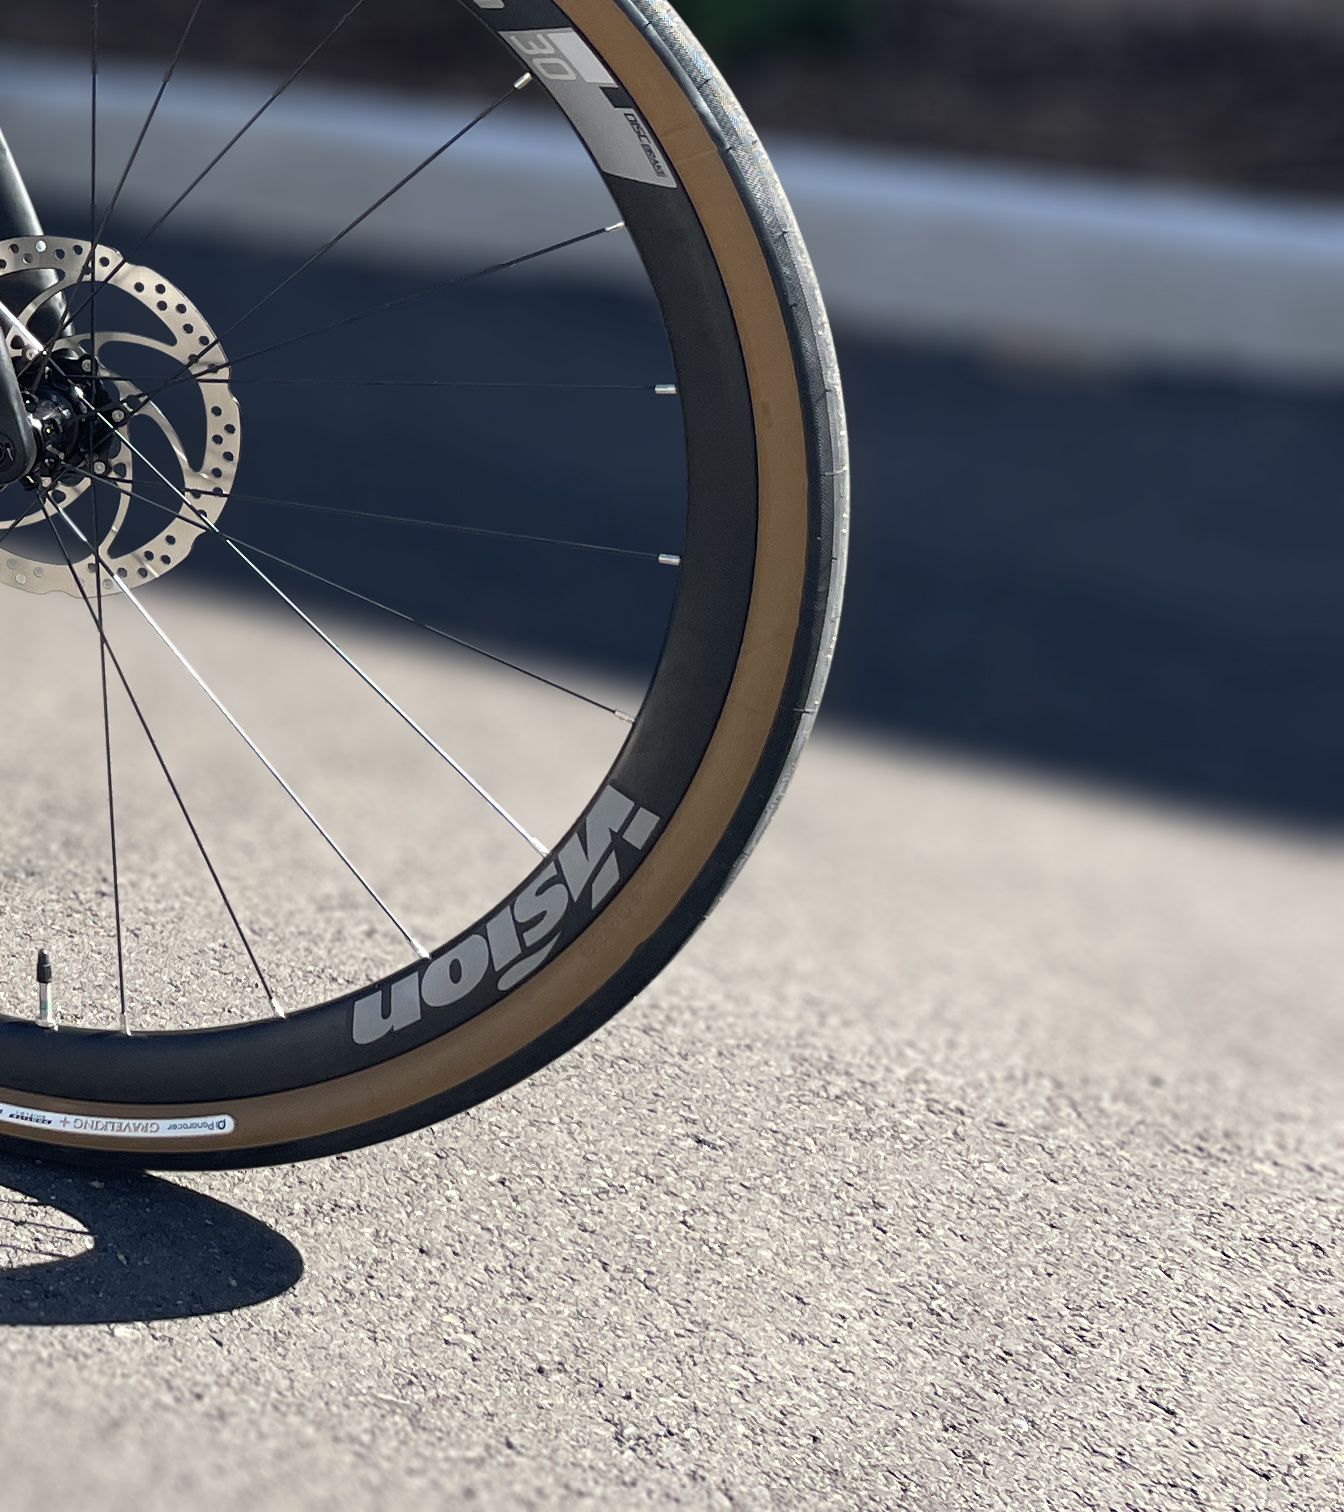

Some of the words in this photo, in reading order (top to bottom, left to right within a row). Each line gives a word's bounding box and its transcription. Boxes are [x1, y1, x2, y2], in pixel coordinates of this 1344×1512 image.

[510, 33, 577, 82] 30
[624, 113, 651, 144] DISC
[73, 1118, 160, 1133] GRAVELKING
